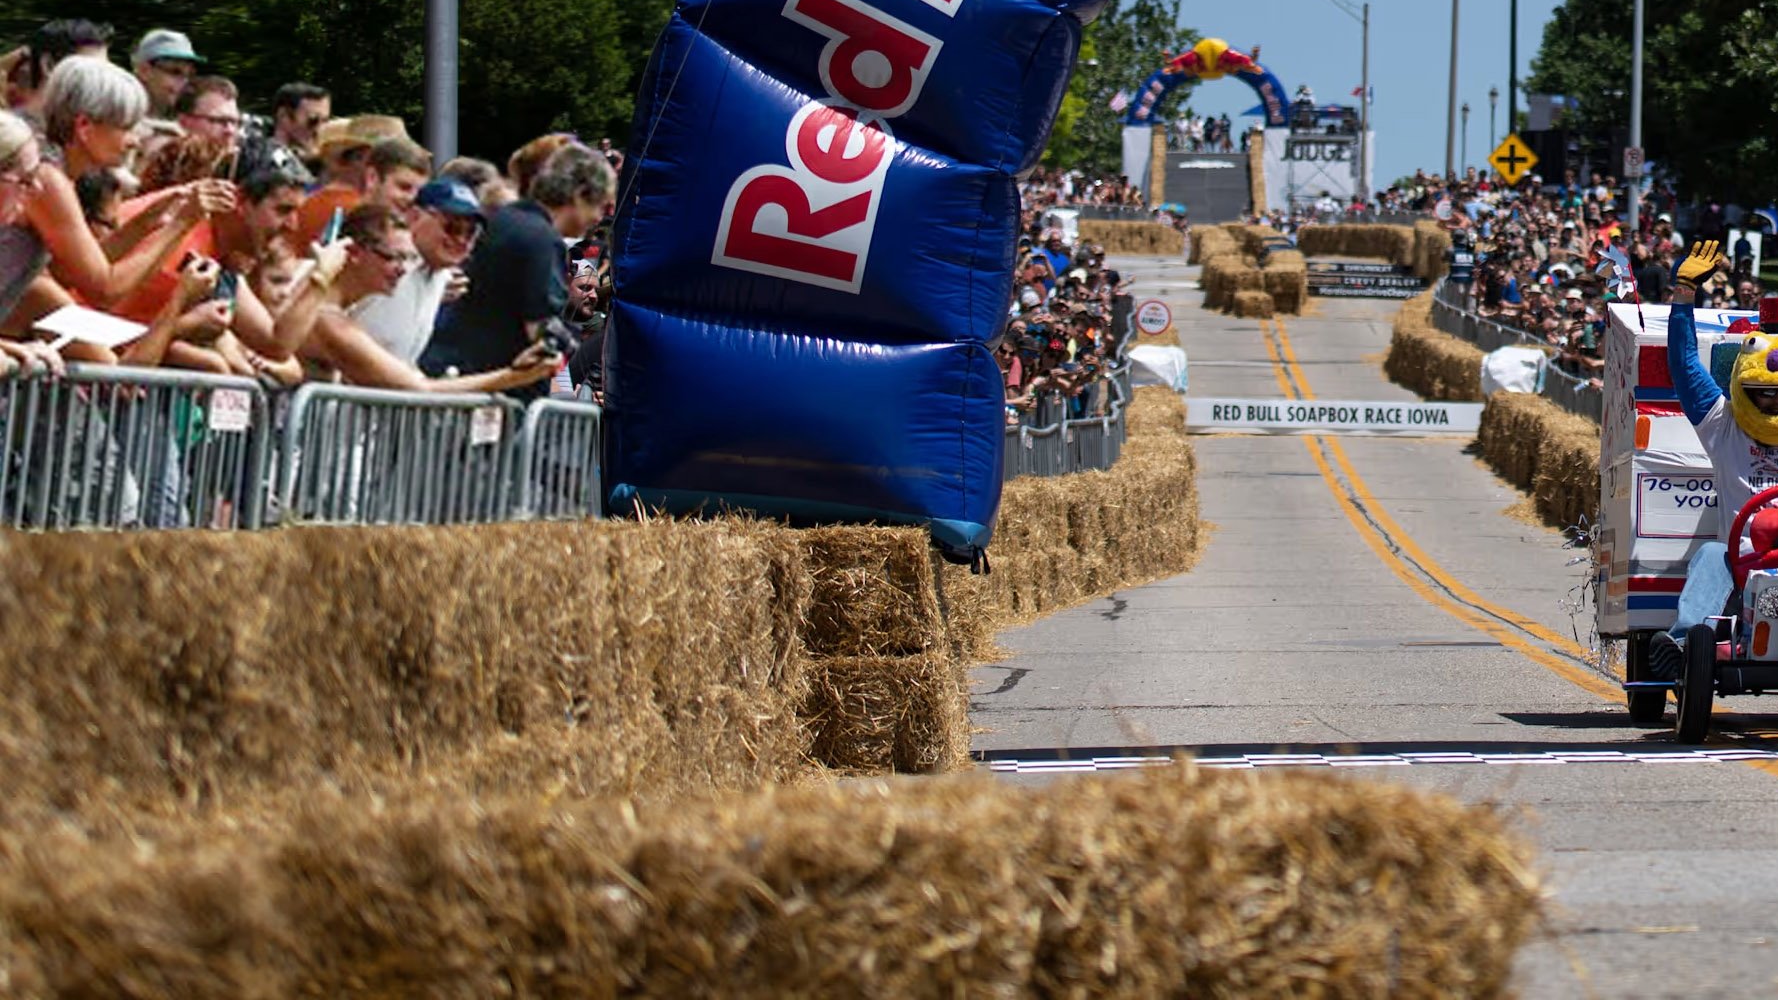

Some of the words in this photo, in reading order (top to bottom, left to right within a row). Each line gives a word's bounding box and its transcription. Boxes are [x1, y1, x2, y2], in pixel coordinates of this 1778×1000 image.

[1212, 405, 1242, 421] RED
[1247, 406, 1282, 422] BULL
[1287, 406, 1359, 424] SOAPBOX
[1364, 407, 1402, 425] RACE
[1407, 408, 1449, 425] IOWA
[1643, 478, 1715, 492] 76-00
[1674, 495, 1718, 508] YOU
